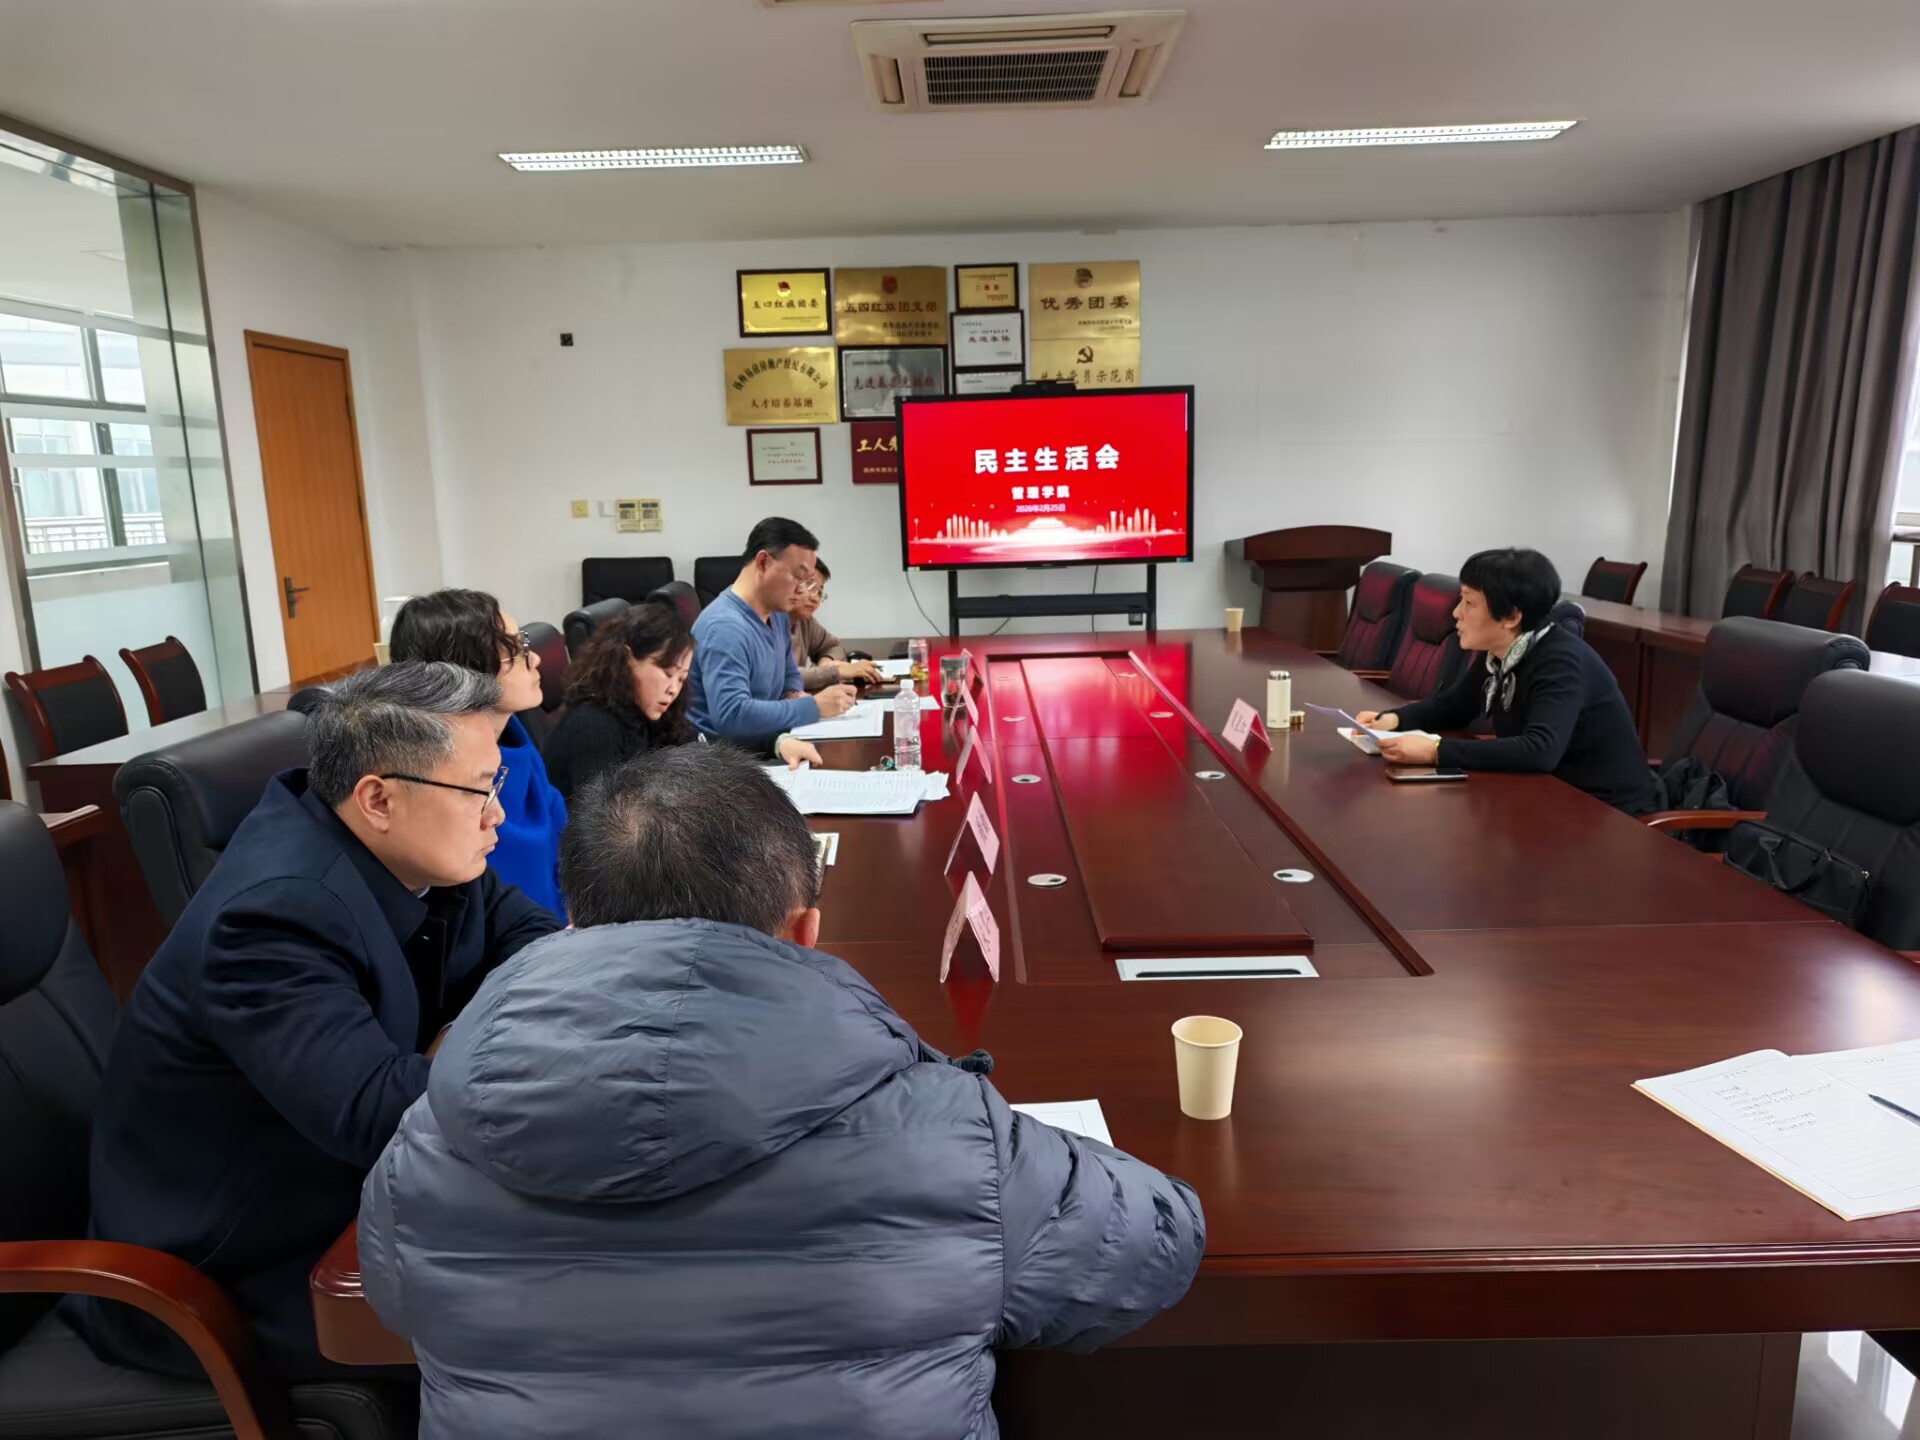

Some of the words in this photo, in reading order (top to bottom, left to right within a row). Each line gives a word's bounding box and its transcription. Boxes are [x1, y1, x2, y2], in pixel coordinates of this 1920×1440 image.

[1040, 295, 1129, 310] 优秀团委
[974, 443, 1120, 474] 民主生活会
[1011, 485, 1070, 500] 管理学院
